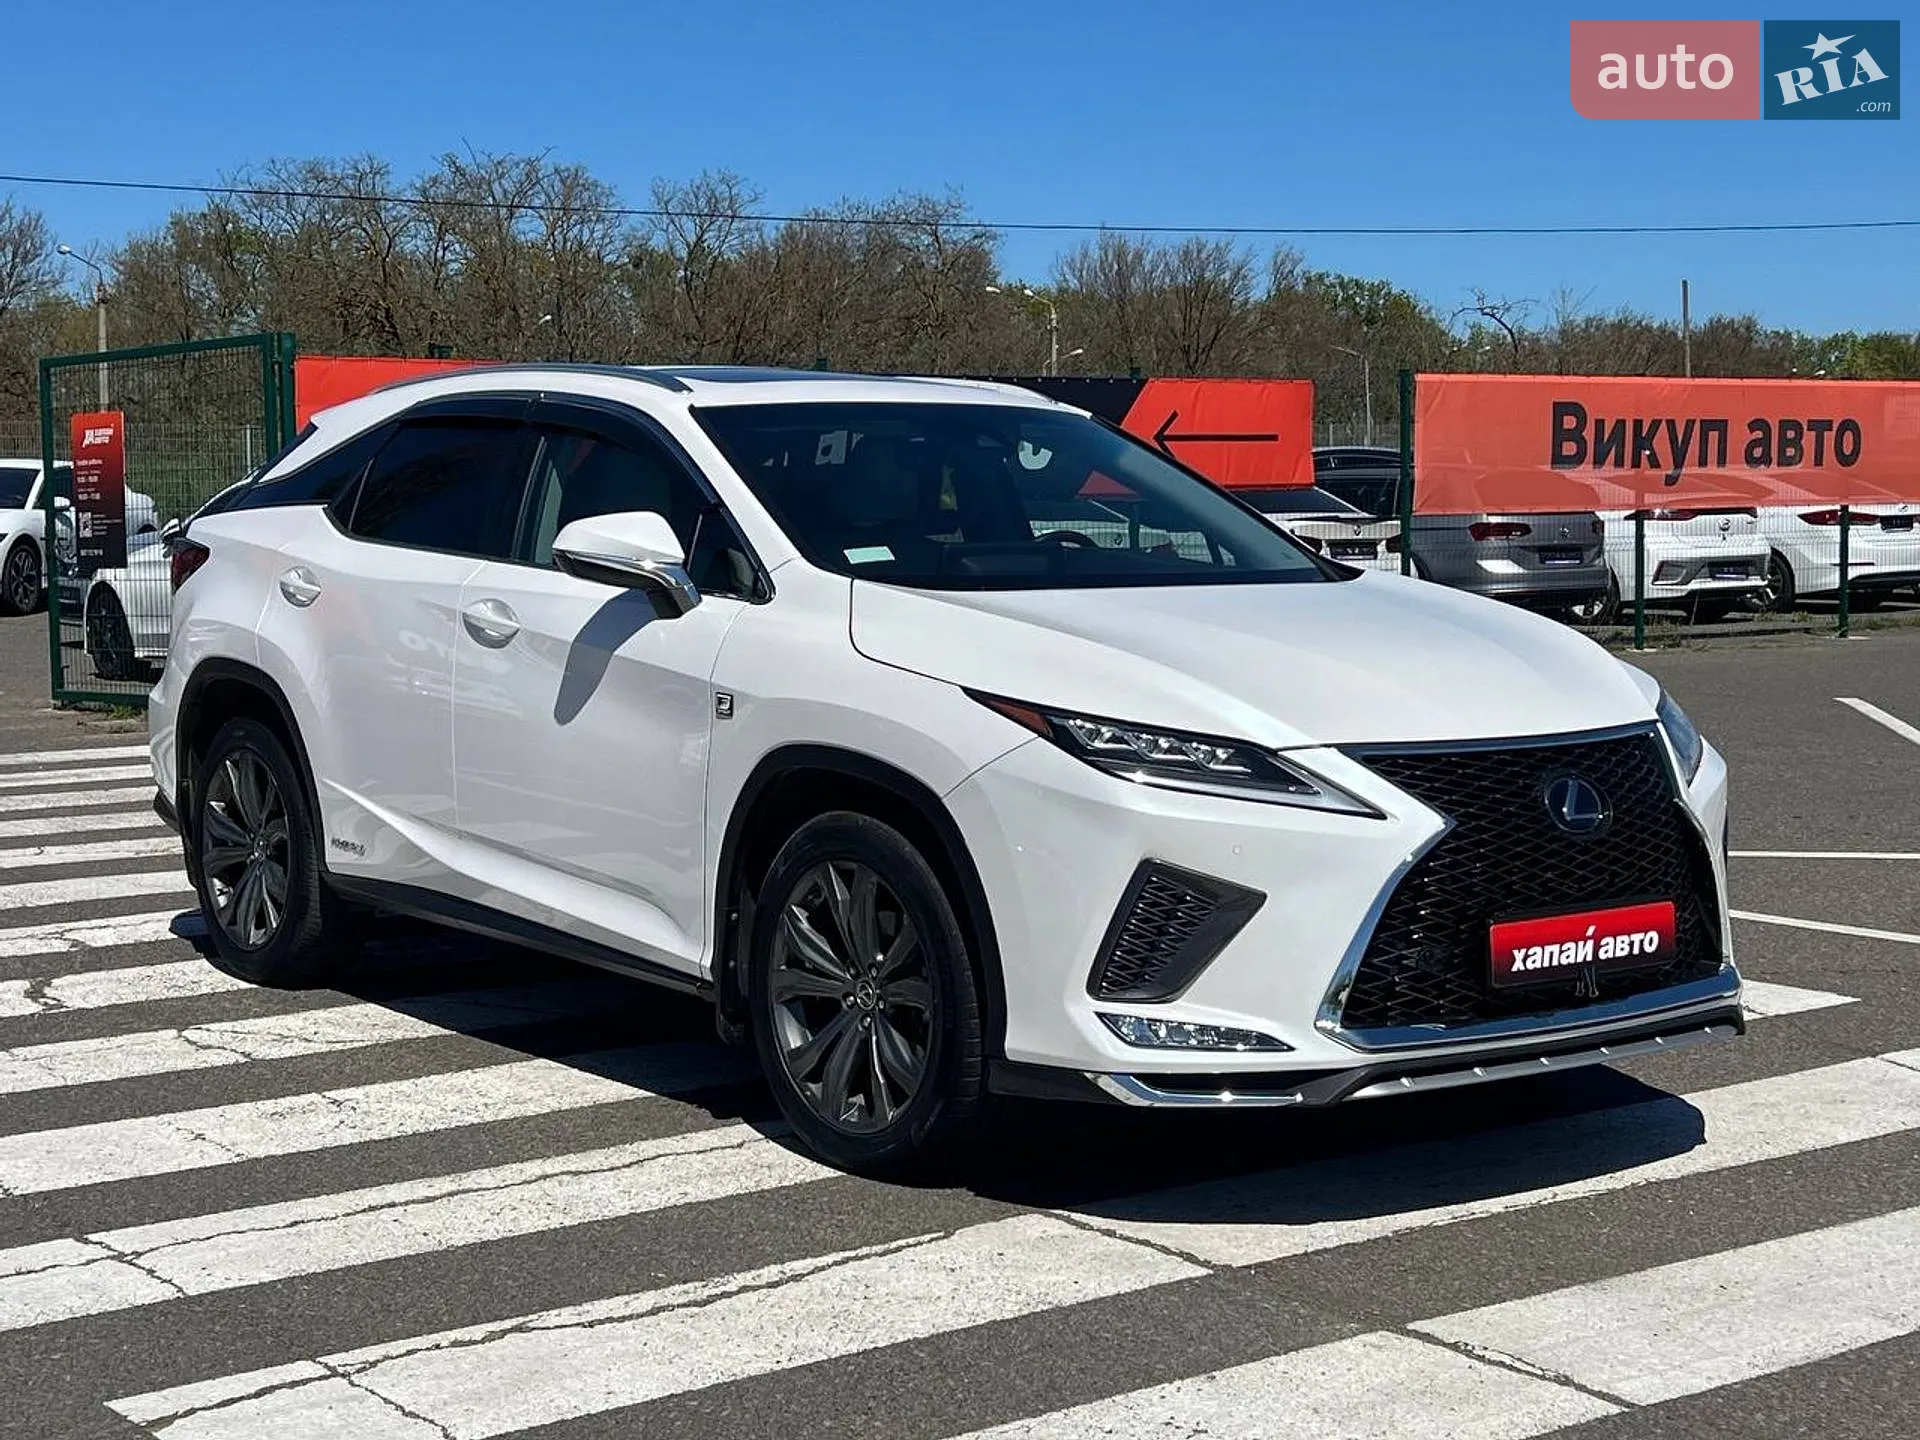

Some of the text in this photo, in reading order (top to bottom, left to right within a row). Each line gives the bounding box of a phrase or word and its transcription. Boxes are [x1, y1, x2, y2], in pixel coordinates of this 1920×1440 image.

[1551, 400, 1862, 487] Викуп авто
[1598, 930, 1659, 960] авто
